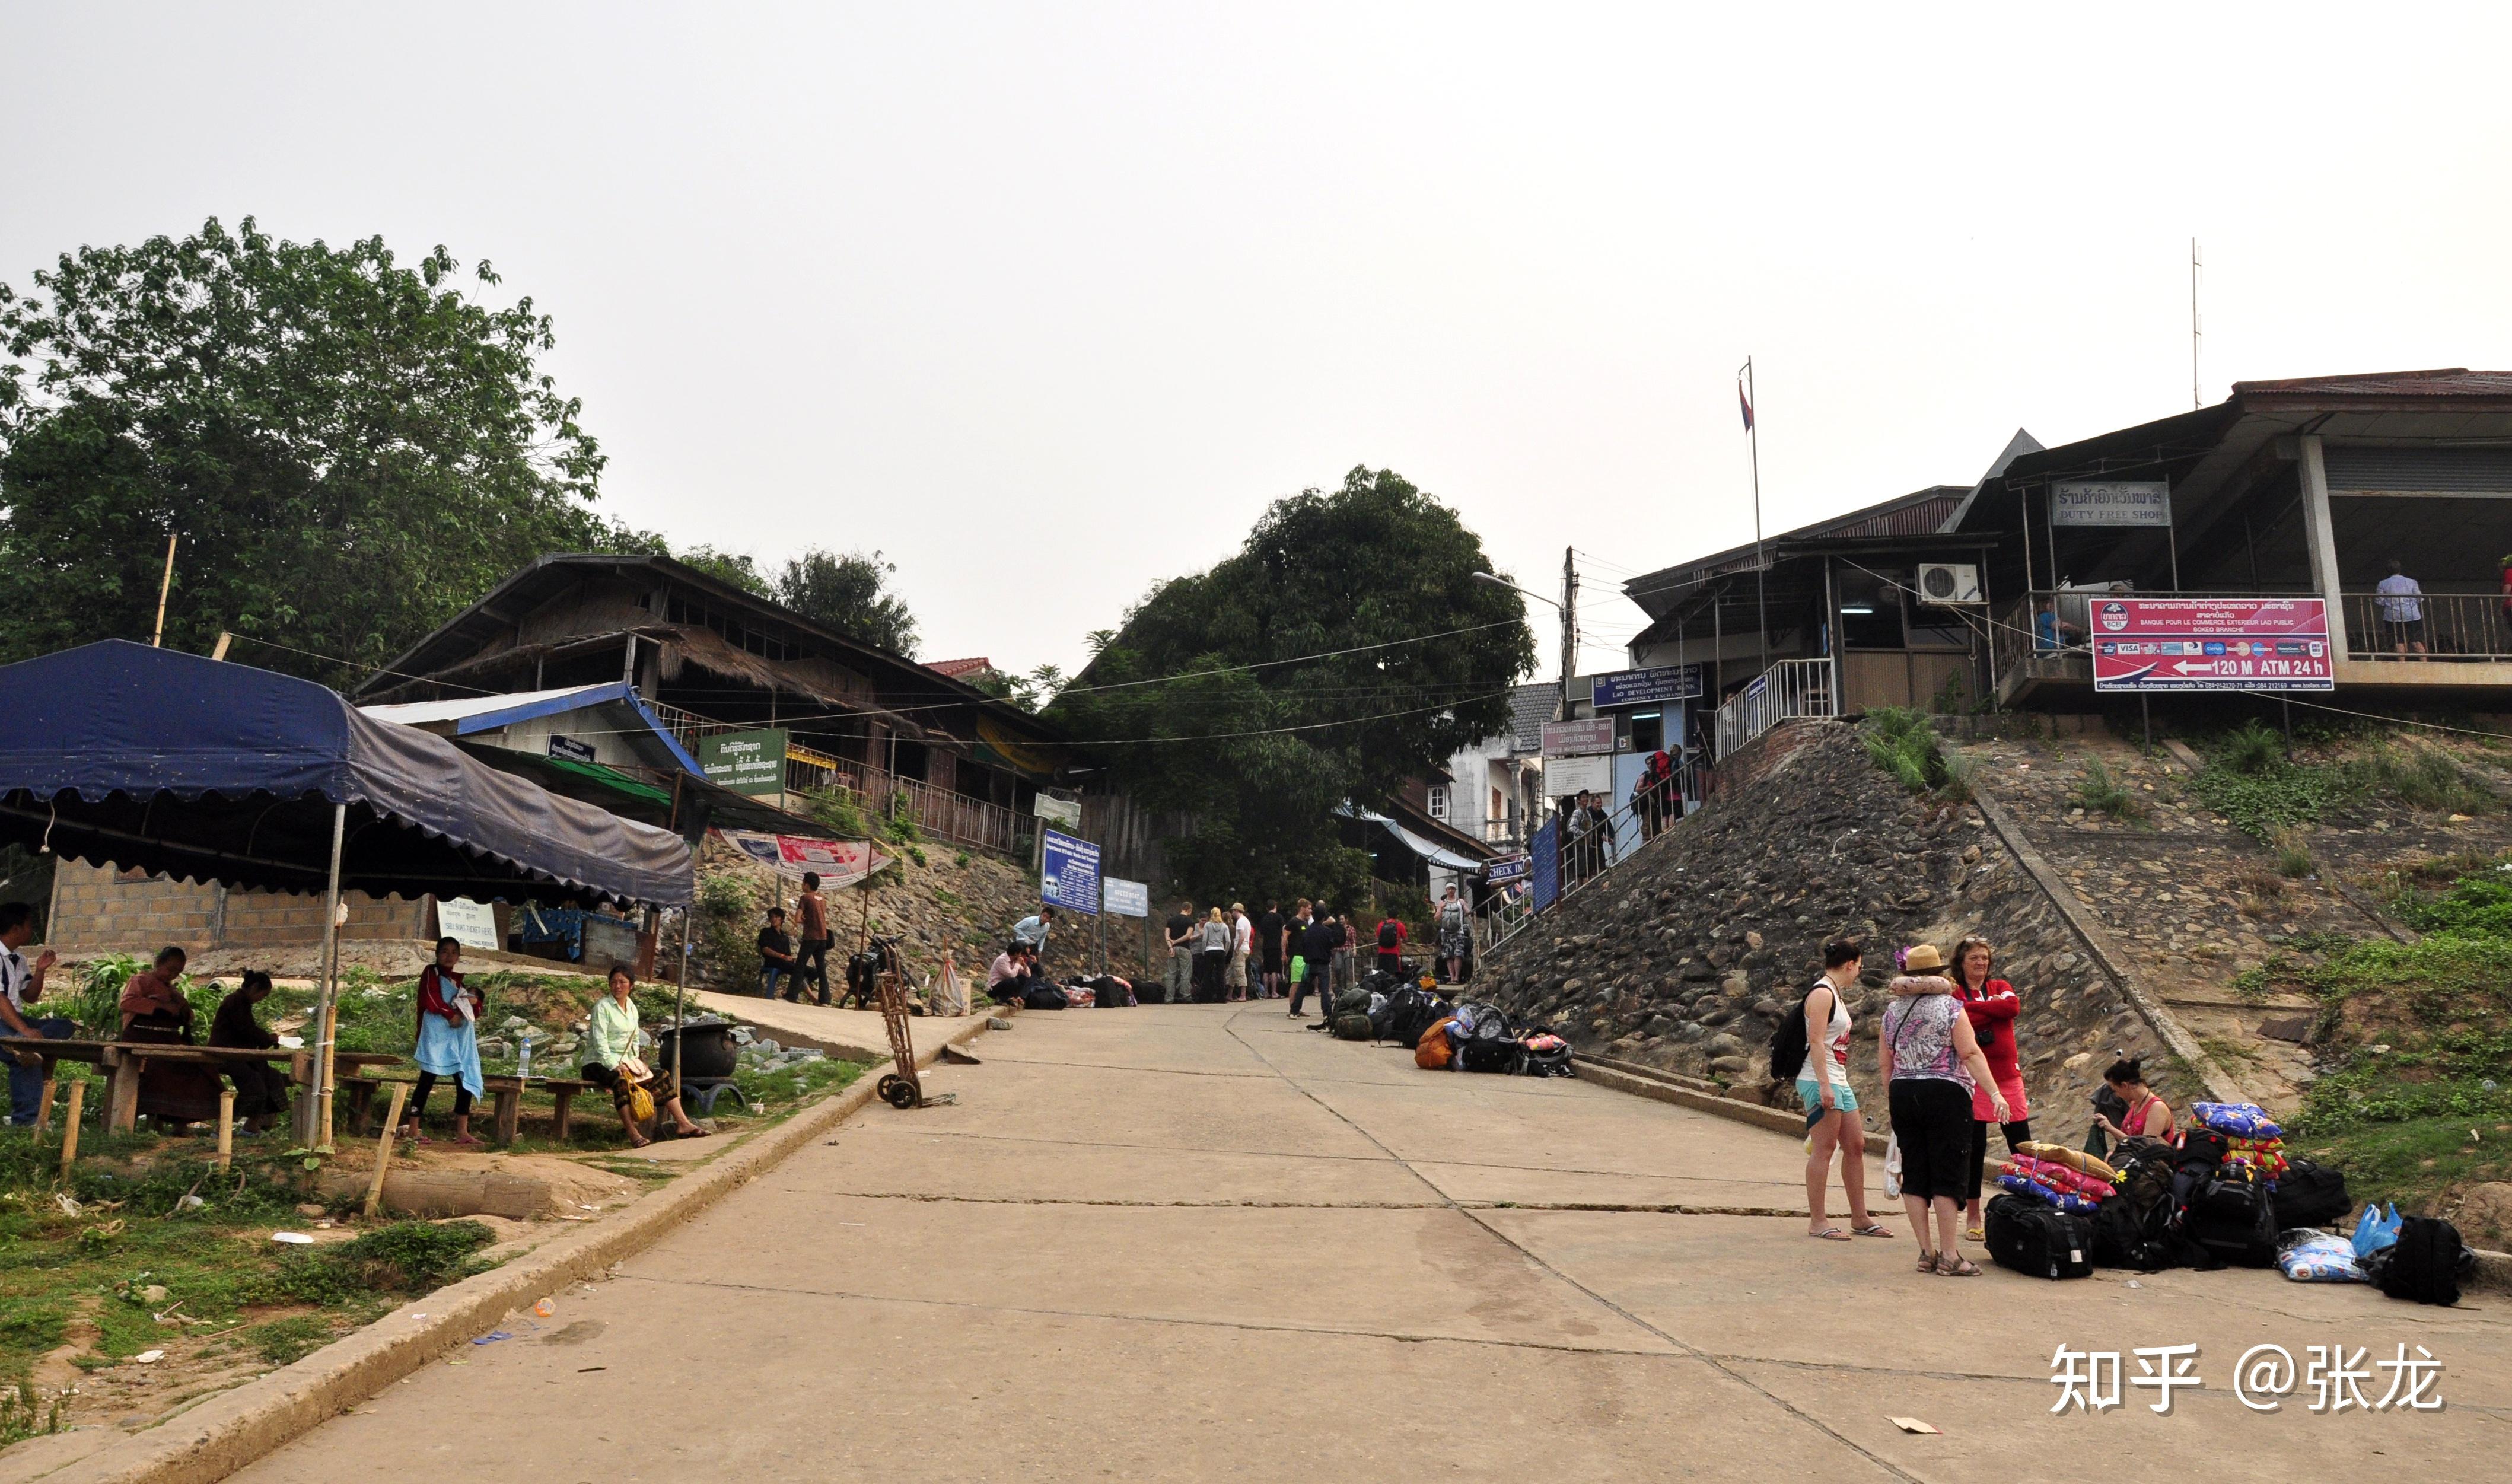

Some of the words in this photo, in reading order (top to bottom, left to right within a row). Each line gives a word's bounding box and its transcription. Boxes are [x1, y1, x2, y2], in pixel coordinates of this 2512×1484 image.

[2060, 511, 2093, 519] DUTY
[2099, 511, 2127, 519] FREE
[2132, 511, 2163, 519] SHOP
[2212, 660, 2237, 675] 120
[2241, 660, 2253, 675] M
[2261, 660, 2290, 675] ATM
[2293, 660, 2311, 675] 24
[2314, 660, 2323, 675] h
[1628, 686, 1673, 696] DEVELOPMENT
[1489, 865, 1513, 878] CHECK
[1514, 863, 1523, 873] IN
